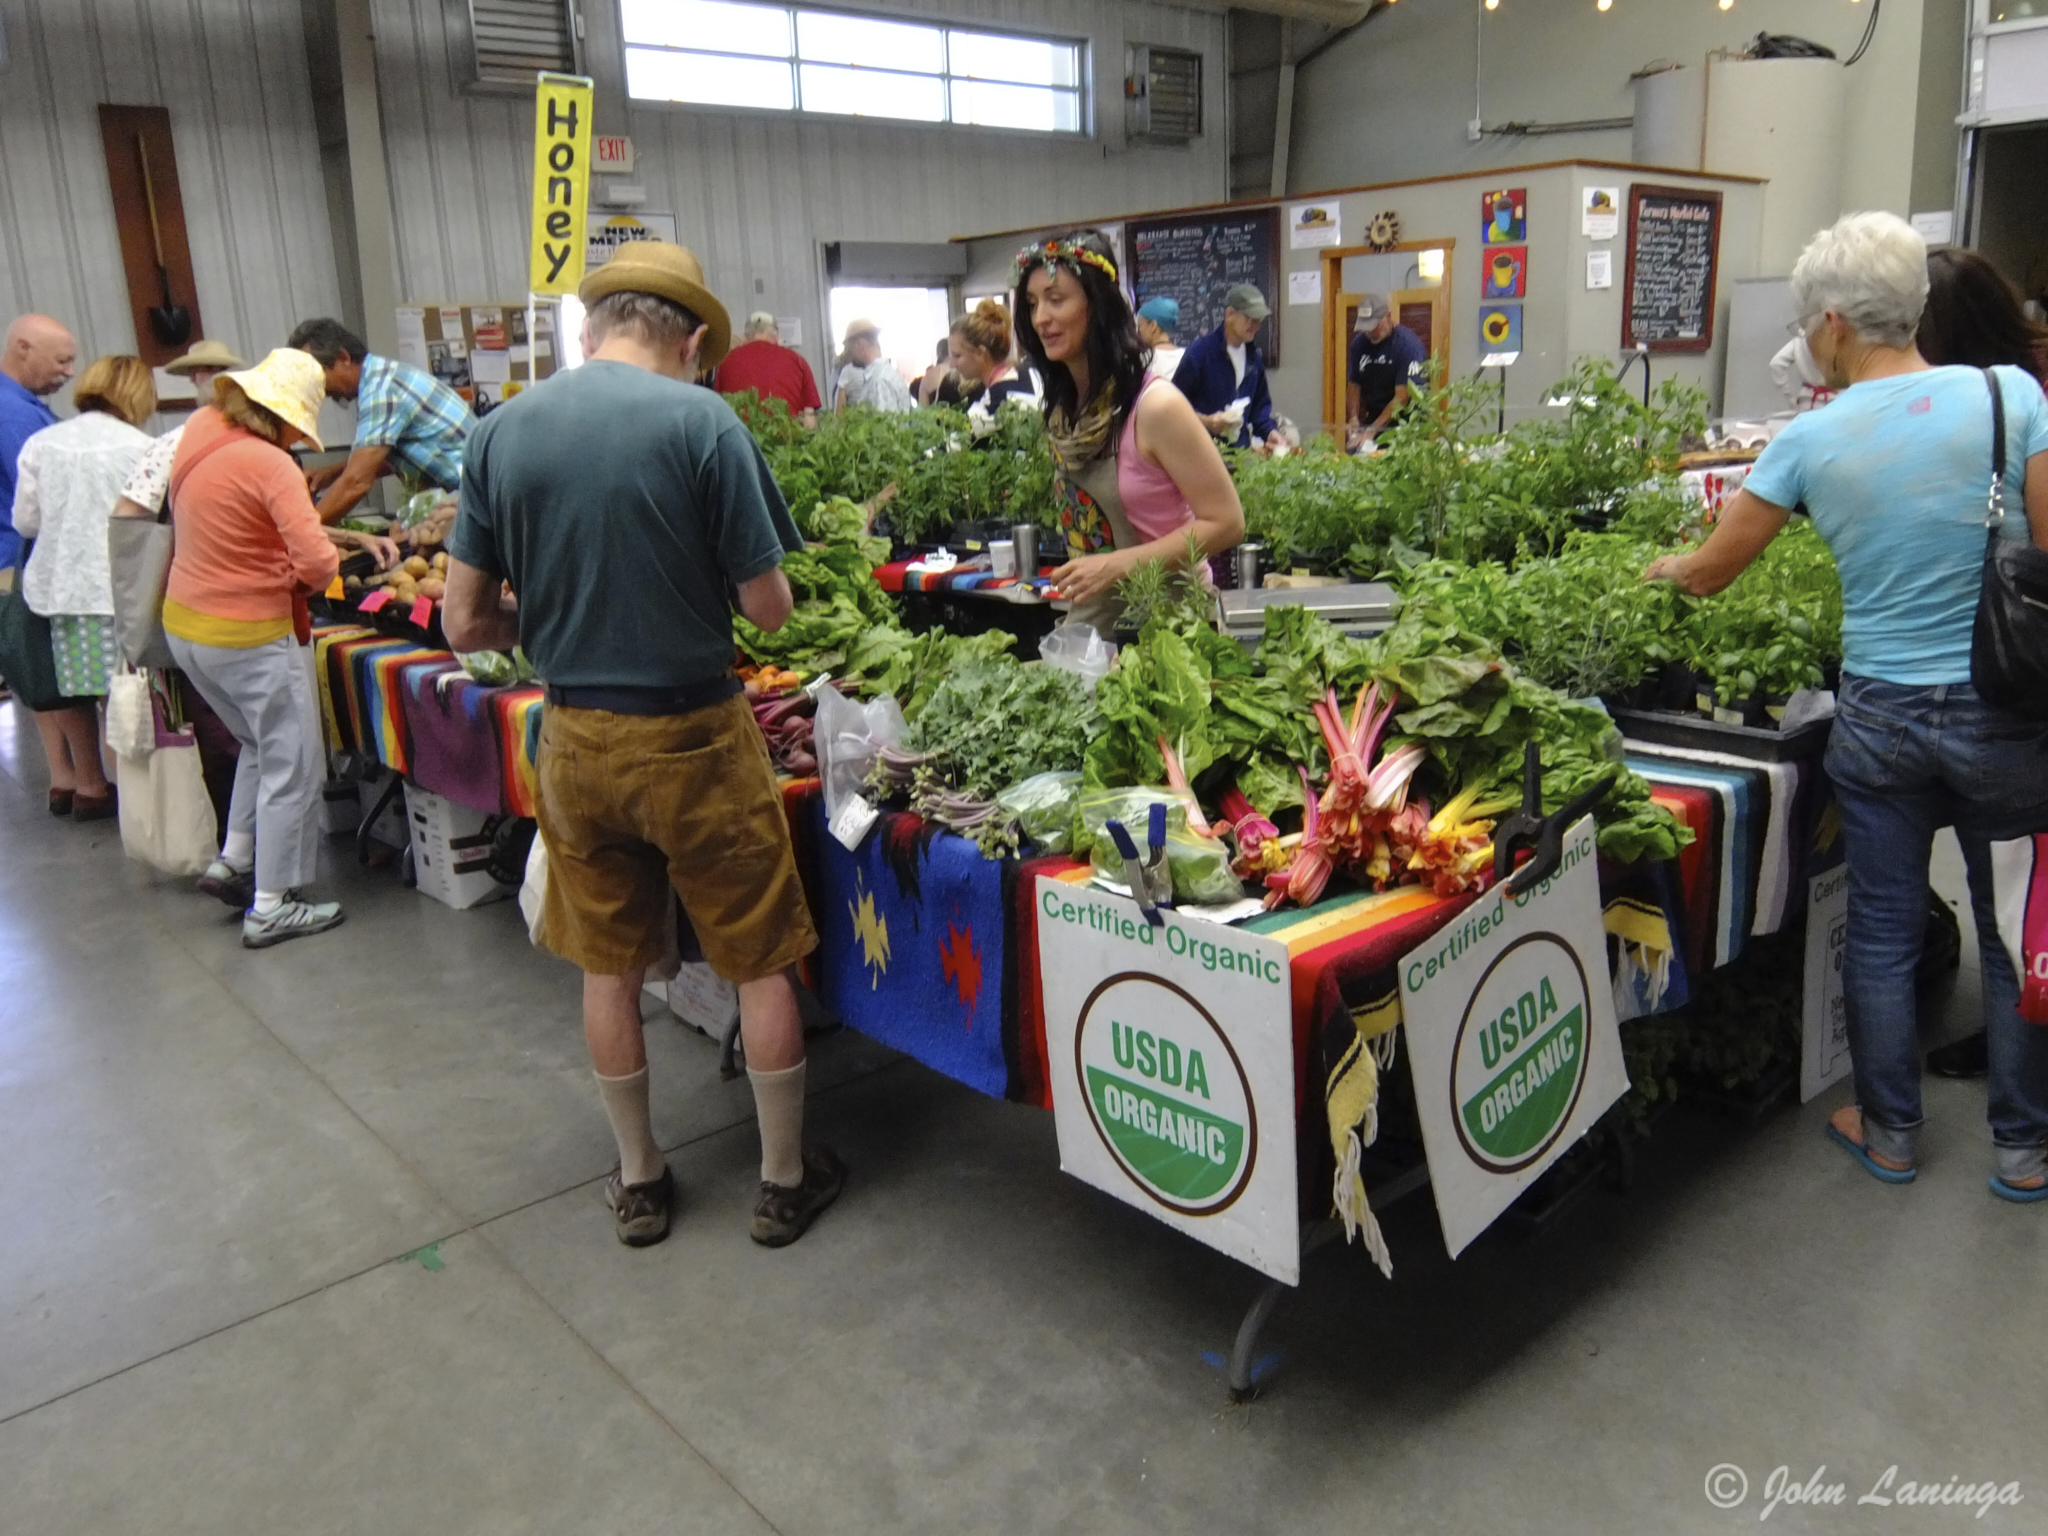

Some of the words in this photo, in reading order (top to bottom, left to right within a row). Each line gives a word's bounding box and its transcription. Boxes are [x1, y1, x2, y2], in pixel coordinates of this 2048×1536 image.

[543, 97, 579, 284] Honey
[598, 136, 626, 161] EXIT
[605, 227, 646, 236] NEW
[1042, 890, 1154, 946] Certified
[1166, 924, 1281, 984] Organic
[1406, 896, 1504, 993] Certified
[1111, 1020, 1211, 1100] USDA
[1478, 975, 1558, 1070] USDA
[1103, 1083, 1226, 1166] ORGANIC
[1479, 1026, 1575, 1134] ORGANIC
